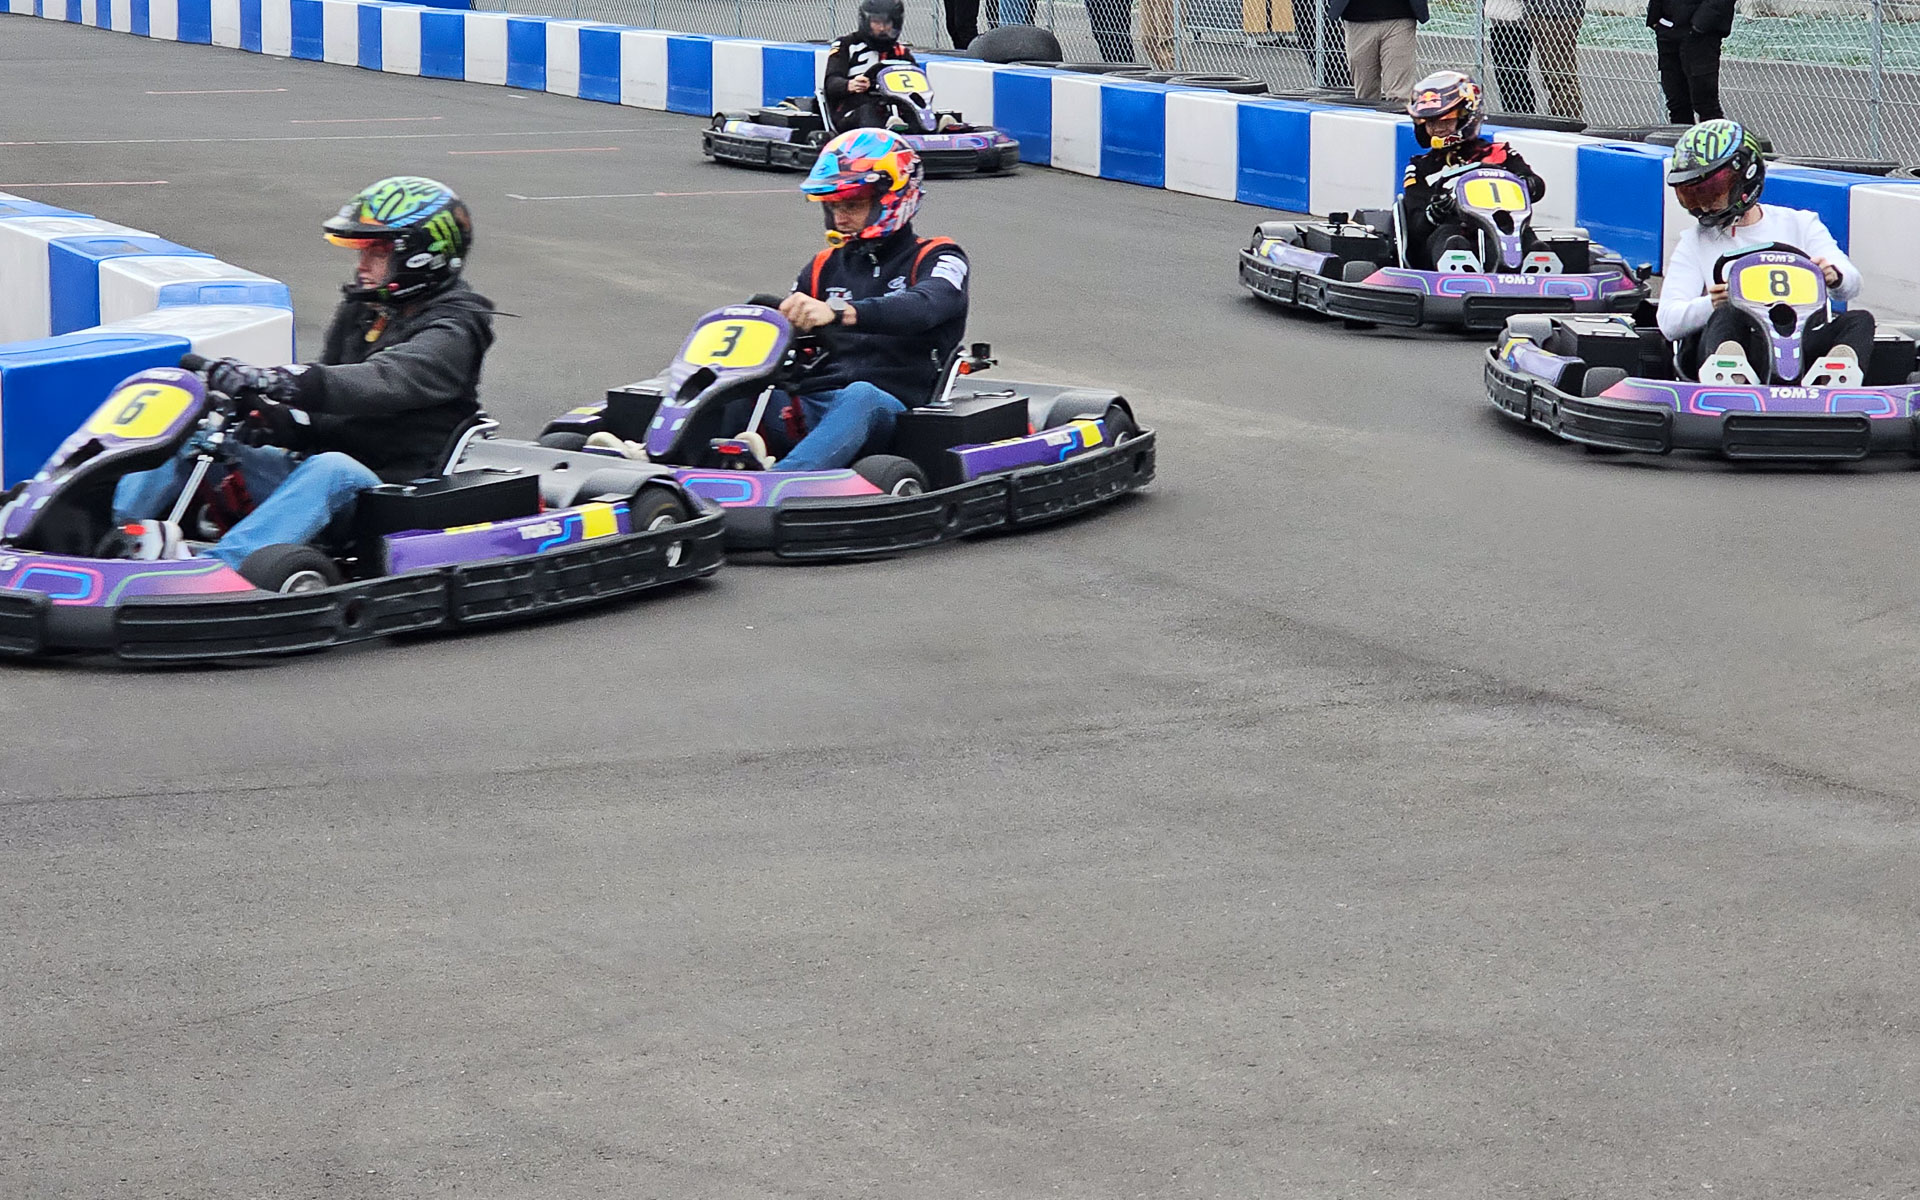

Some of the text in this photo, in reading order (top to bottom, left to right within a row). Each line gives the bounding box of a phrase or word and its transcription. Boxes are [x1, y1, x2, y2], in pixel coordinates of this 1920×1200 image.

[899, 74, 915, 88] 2
[1477, 170, 1506, 178] TOM'S
[1489, 182, 1501, 204] 1
[1760, 253, 1797, 263] TOM'S
[1497, 274, 1536, 285] TOM'S
[1769, 270, 1791, 297] 8
[710, 325, 744, 357] 3
[1769, 386, 1820, 399] TOM'S
[114, 389, 162, 425] 6
